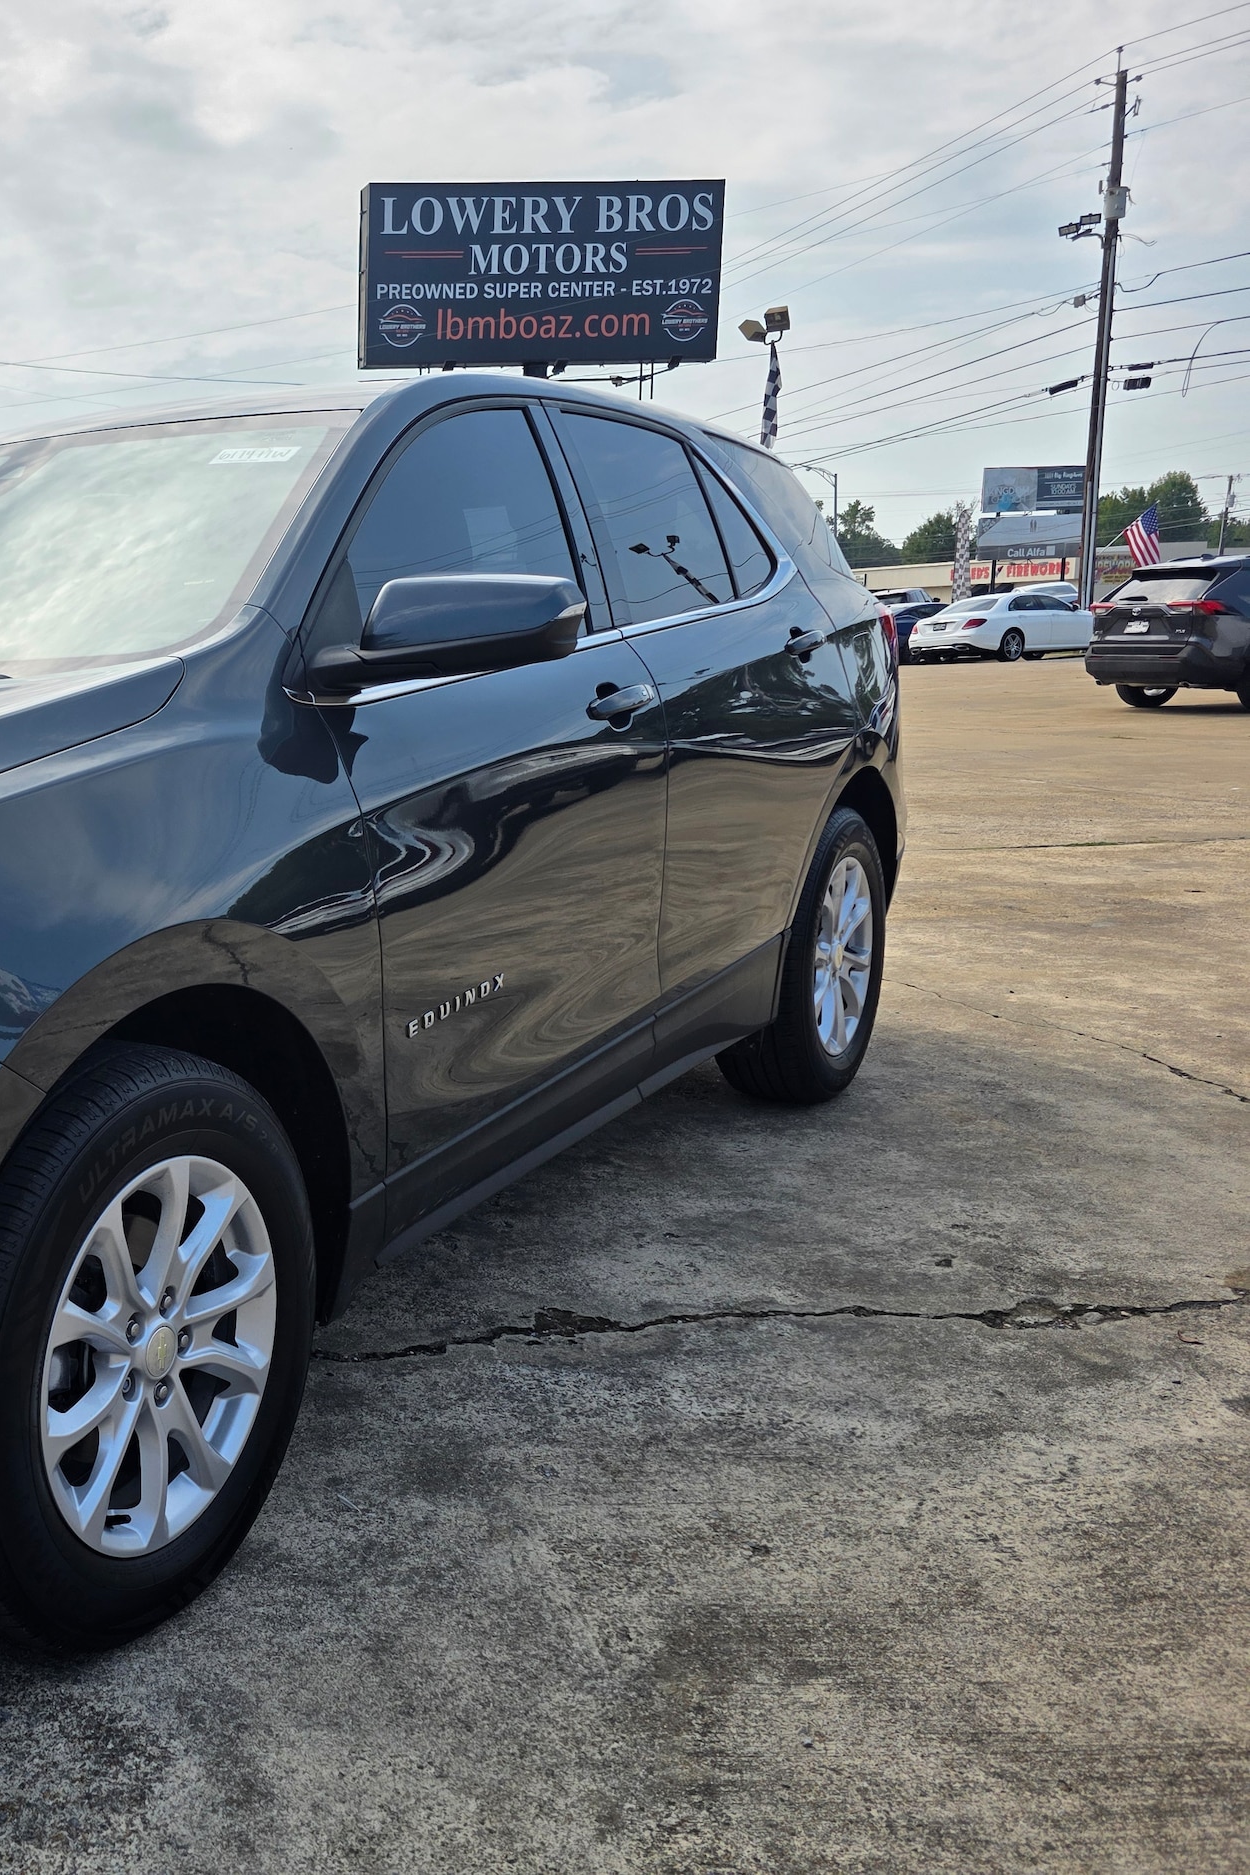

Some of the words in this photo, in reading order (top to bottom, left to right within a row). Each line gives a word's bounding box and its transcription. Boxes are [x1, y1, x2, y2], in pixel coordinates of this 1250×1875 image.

[379, 196, 583, 236] LOWERY
[594, 192, 715, 233] BROS
[468, 241, 628, 276] MOTORS
[376, 283, 479, 300] PREOWNED
[483, 282, 542, 299] SUPER
[547, 280, 616, 298] CENTER
[631, 277, 713, 296] EST.1972
[437, 308, 650, 340] lbmboaz.com
[1007, 548, 1025, 558] Call
[1026, 547, 1046, 557] Alfa
[407, 973, 505, 1038] EQUINOX
[78, 1098, 215, 1202] ULTRAMAX
[219, 1103, 259, 1132] A/S
